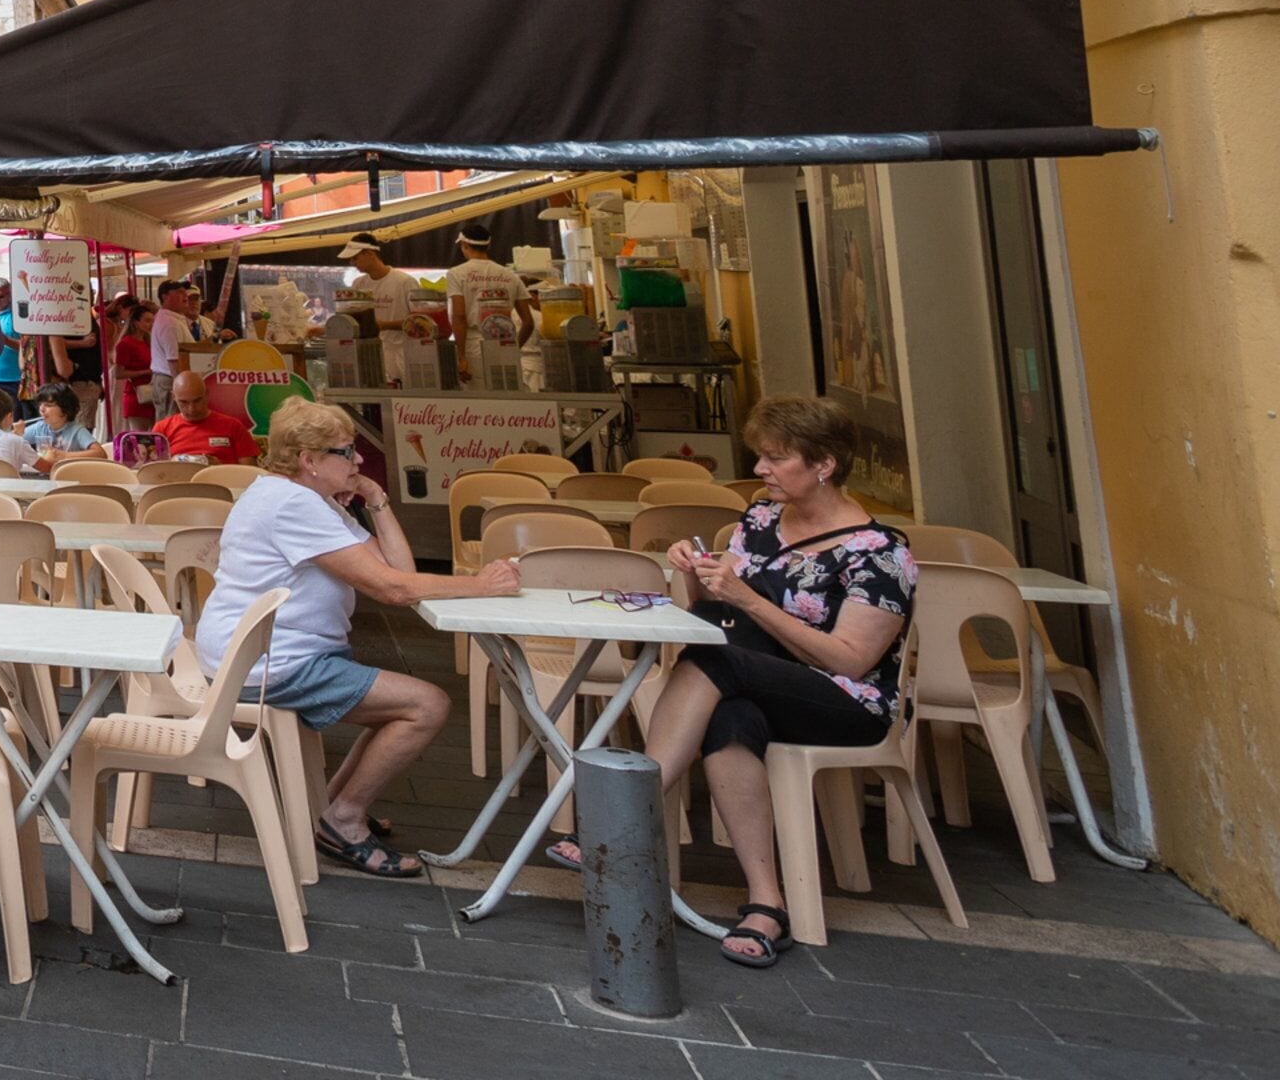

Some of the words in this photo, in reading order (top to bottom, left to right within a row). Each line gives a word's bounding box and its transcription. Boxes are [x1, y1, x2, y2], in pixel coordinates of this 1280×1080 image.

[218, 371, 289, 384] POUBELLE
[395, 402, 445, 435] Veuillez
[483, 414, 505, 428] vos
[508, 409, 556, 429] cornets
[440, 439, 453, 458] et
[452, 439, 486, 463] petits
